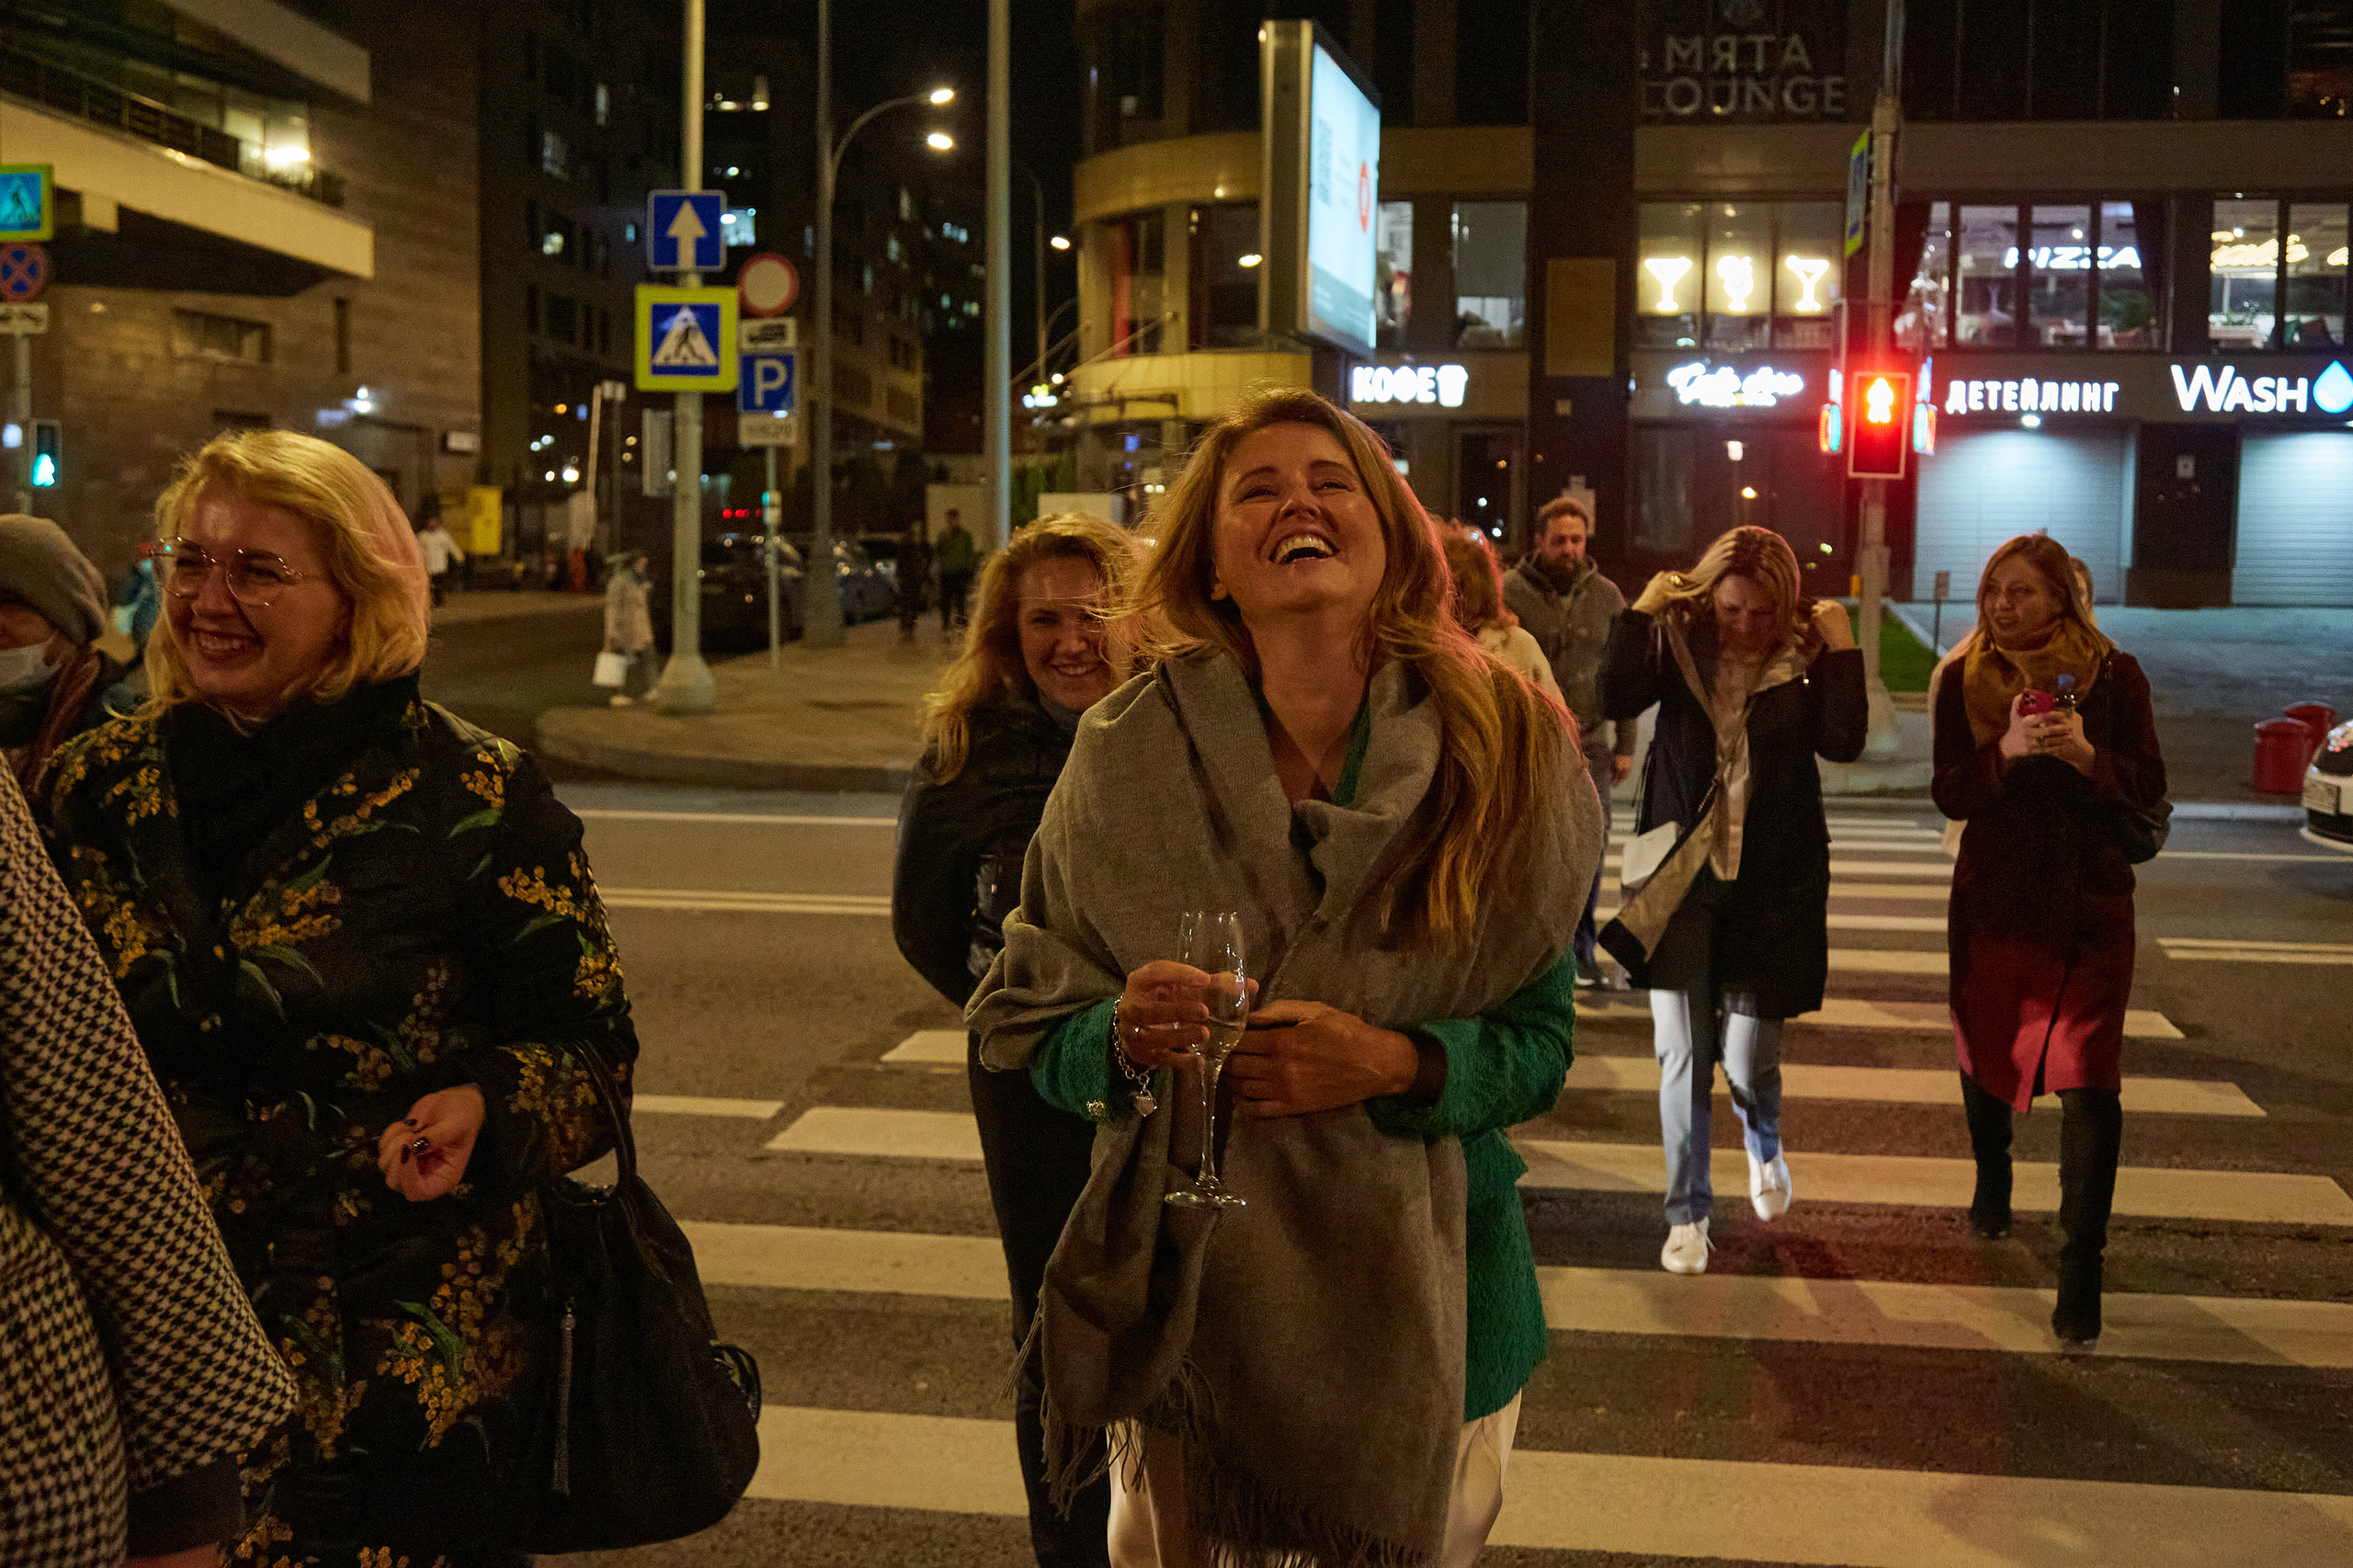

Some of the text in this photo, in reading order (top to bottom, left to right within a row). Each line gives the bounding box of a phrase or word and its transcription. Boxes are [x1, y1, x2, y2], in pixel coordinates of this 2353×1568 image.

[1665, 35, 1813, 73] МЯТА
[1642, 76, 1846, 115] LOUNGE
[2004, 246, 2143, 268] PIZZA
[755, 359, 787, 406] P
[1352, 366, 1437, 403] КОФЕ
[1945, 378, 2120, 415] ДЕТЕЙЛИНГ
